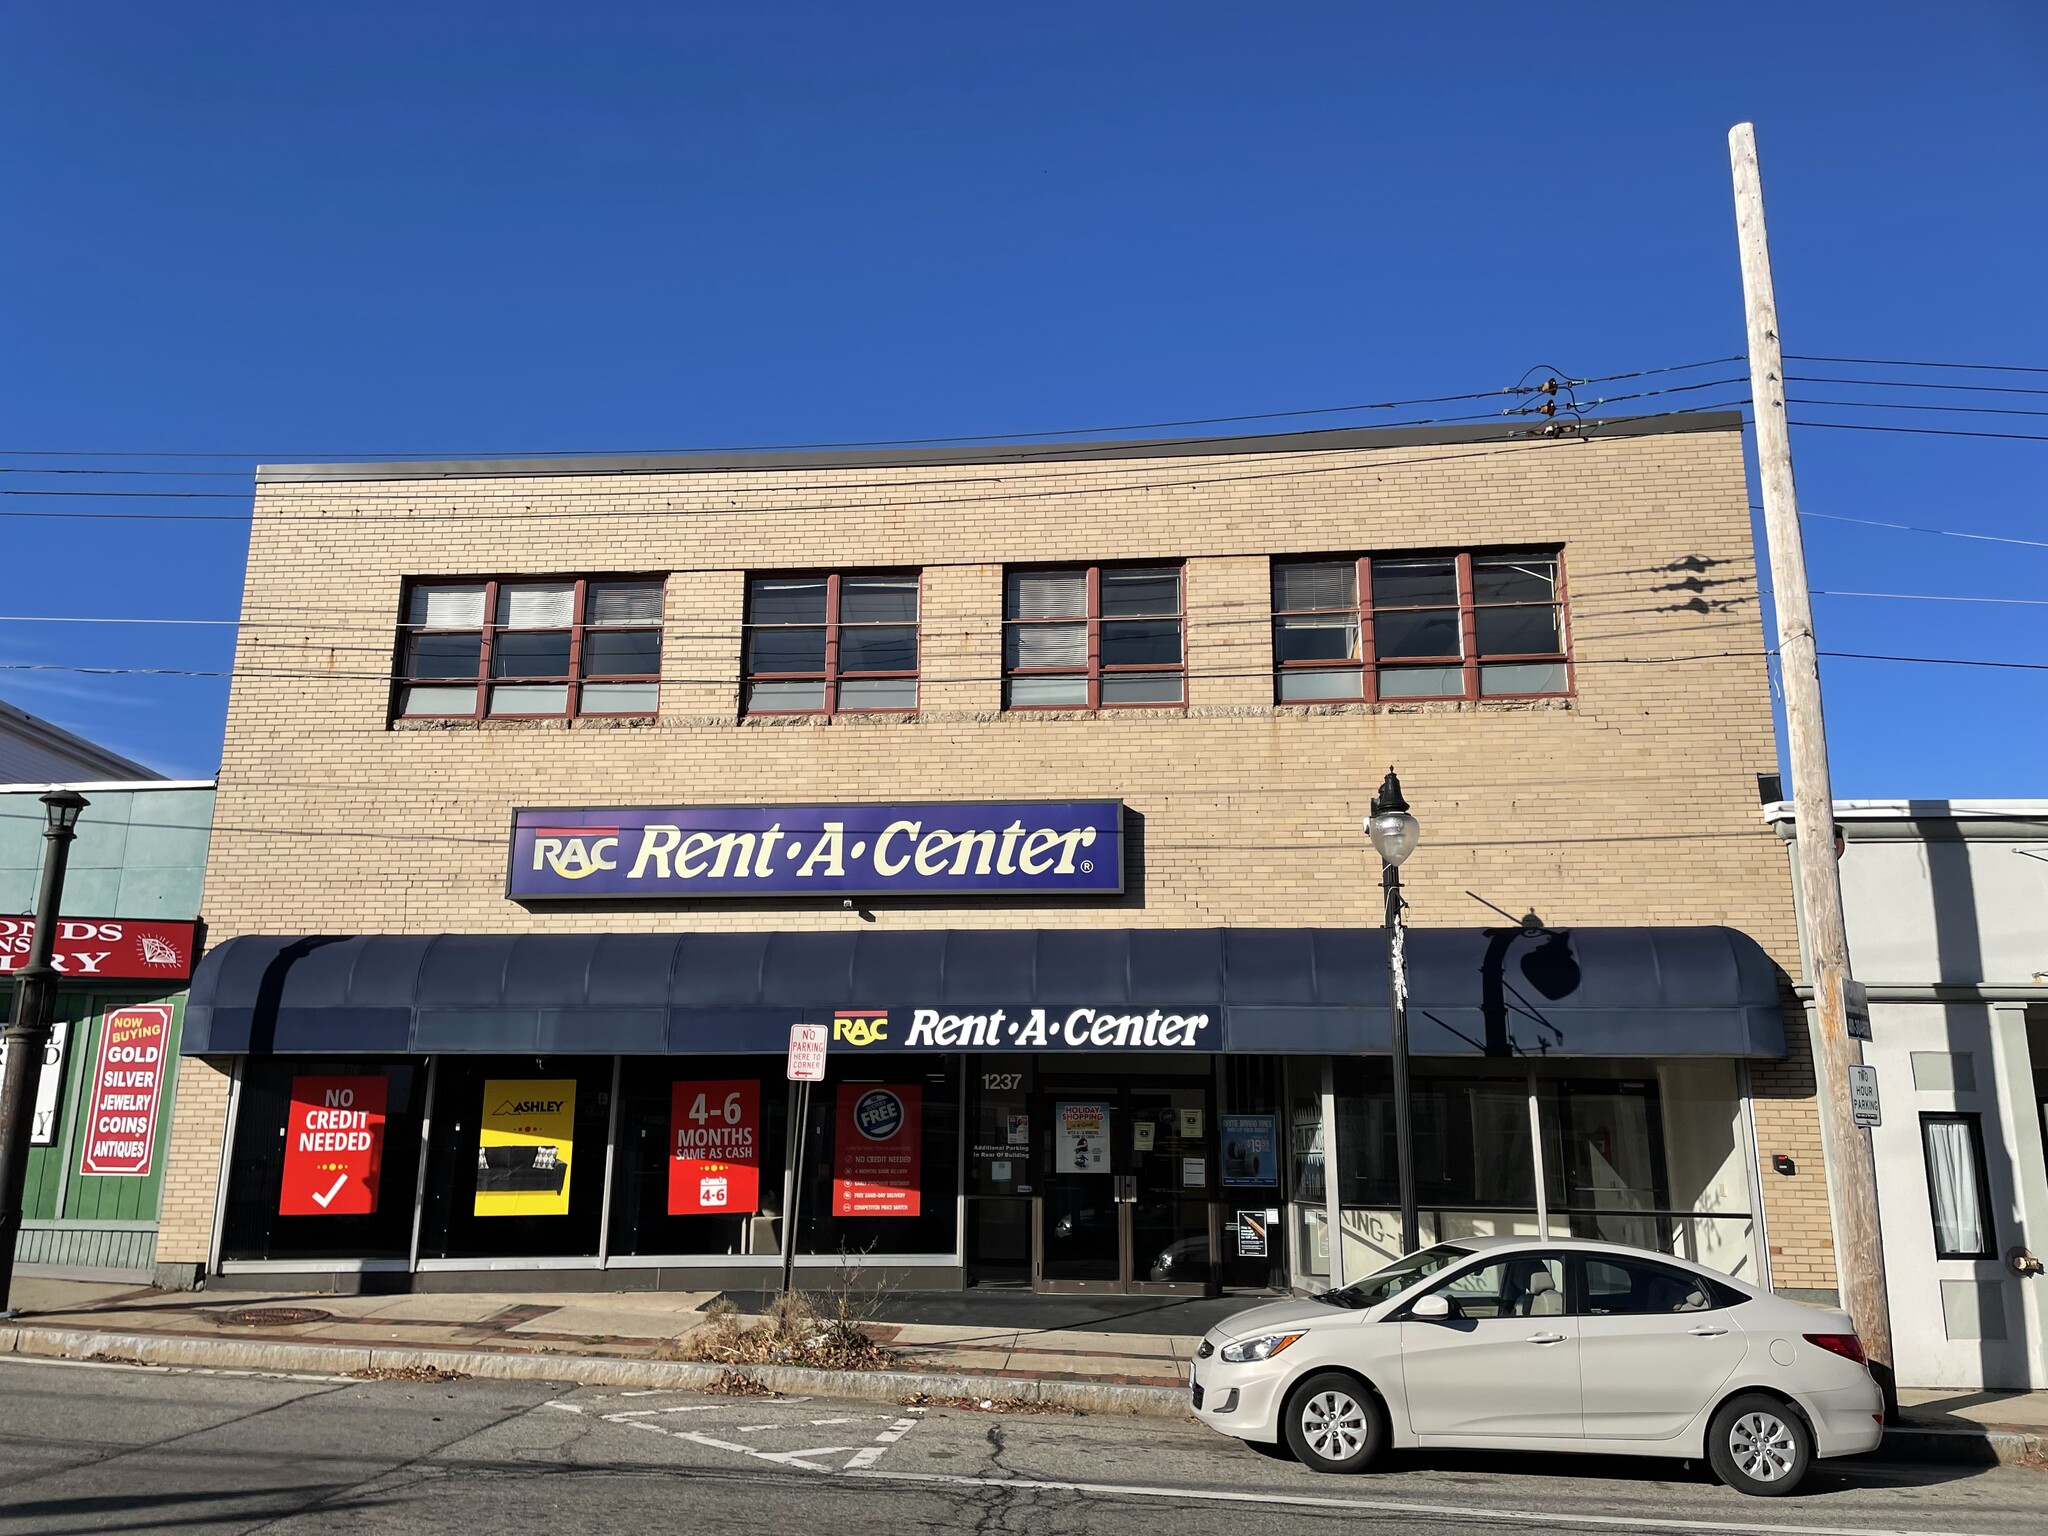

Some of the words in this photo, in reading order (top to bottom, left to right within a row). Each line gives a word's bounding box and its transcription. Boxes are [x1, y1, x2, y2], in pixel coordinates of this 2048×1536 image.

[533, 834, 619, 879] RAC
[114, 1017, 143, 1029] NOW
[112, 1024, 161, 1043] BUYING
[803, 1030, 816, 1041] NO
[833, 1018, 889, 1046] RAC
[107, 1046, 158, 1064] GOLD
[793, 1041, 825, 1053] PARKING
[793, 1061, 821, 1070] CORNER
[794, 1053, 811, 1061] HERE
[103, 1071, 155, 1088] SILVER
[982, 1073, 1022, 1091] 1237
[1858, 1070, 1869, 1082] TWO
[325, 1088, 354, 1108] NO
[1856, 1086, 1873, 1096] HOUR
[100, 1094, 152, 1112] JEWELRY
[514, 1101, 565, 1113] ASHLEY
[688, 1092, 742, 1126] 4-6
[1065, 1106, 1101, 1114] HOLIDAY
[1854, 1099, 1879, 1111] PARKING
[305, 1110, 368, 1129] CREDIT
[861, 1103, 898, 1128] FREE
[1062, 1113, 1104, 1121] SHOPPING
[99, 1116, 147, 1133] COINS
[299, 1131, 371, 1152] NEEDED
[677, 1128, 753, 1147] MONTHS
[93, 1140, 144, 1158] ANTIQUES
[676, 1149, 706, 1160] SAME
[708, 1148, 722, 1159] AS
[725, 1146, 752, 1158] CASH
[855, 1155, 866, 1163] NO
[867, 1155, 887, 1163] CREDIT
[888, 1155, 912, 1163] NEEDED
[701, 1189, 725, 1202] 4-6
